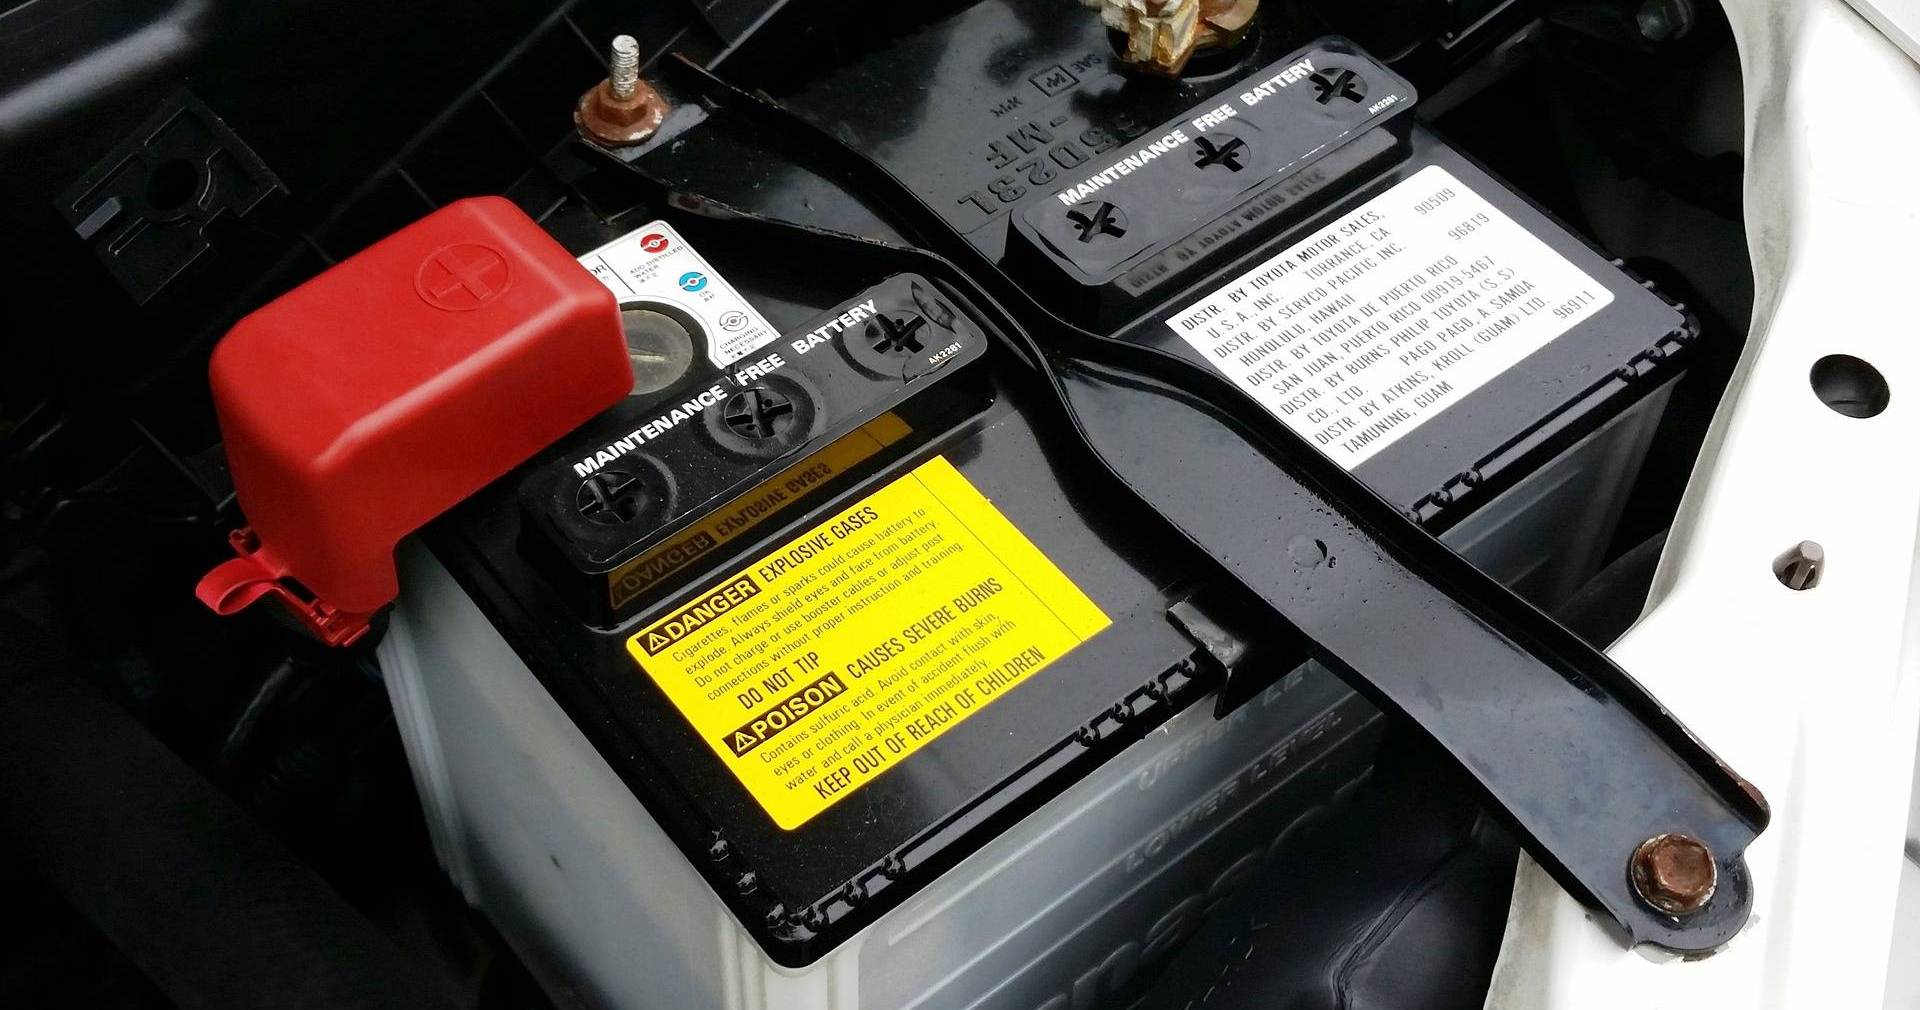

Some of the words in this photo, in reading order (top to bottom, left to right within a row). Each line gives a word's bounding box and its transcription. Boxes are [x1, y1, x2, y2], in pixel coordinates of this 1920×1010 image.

[1057, 129, 1190, 206] MAINTENANCE
[1192, 103, 1238, 132] FREE
[1239, 58, 1316, 107] BATTERY
[1226, 286, 1250, 303] BY
[1247, 258, 1299, 291] TOYOTA
[1294, 233, 1342, 263] MOTOR
[1337, 207, 1386, 238] SALES,
[1367, 225, 1392, 242] CA
[1411, 186, 1457, 216] 90509
[633, 264, 660, 278] WATER
[1237, 320, 1312, 368] HONOLULU,
[1307, 292, 1357, 325] HAWAII
[1445, 211, 1491, 241] 96819
[1255, 315, 1280, 332] BY
[1276, 285, 1329, 320] SERVCO
[1325, 256, 1379, 290] PACIFIC
[1288, 342, 1313, 360] BY
[1309, 313, 1361, 347] TOYOTA
[1357, 300, 1381, 317] DE
[1376, 272, 1428, 306] PUERTO
[1424, 254, 1459, 277] RICO
[573, 384, 729, 478] MAINTENANCE
[734, 353, 787, 387] FREE
[791, 299, 879, 355] BATTERY
[720, 327, 758, 349] CHARGING
[725, 330, 768, 354] NECESSARY
[928, 341, 962, 364] AK2281
[1270, 372, 1305, 396] SAN
[1300, 348, 1345, 378] JUAN,
[1338, 319, 1390, 354] PUERTO
[1387, 299, 1422, 324] RICO
[1322, 370, 1348, 388] BY
[1343, 342, 1392, 375] BURNS
[1388, 316, 1434, 348] PHILIP
[1430, 287, 1482, 322] TOYOTA
[1339, 402, 1418, 457] TAMUNING,
[1411, 379, 1454, 409] GUAM
[1551, 289, 1596, 320] 96911
[1357, 399, 1382, 417] BY
[1378, 366, 1436, 406] ATKINS,
[1430, 340, 1475, 372] KROLL
[1397, 338, 1438, 366] PAGO
[1435, 313, 1481, 345] PAGO,
[661, 577, 758, 641] DANGER
[757, 531, 835, 583] EXPLOSIVE
[828, 504, 880, 540] GASES
[670, 621, 734, 664] Cigarettes,
[730, 599, 770, 627] flames
[768, 593, 783, 605] or
[779, 570, 819, 598] sparks
[814, 553, 847, 576] could
[844, 536, 877, 559] cause
[873, 513, 915, 542] battery
[911, 506, 927, 519] to
[693, 671, 713, 688] Do
[711, 660, 733, 677] not
[730, 637, 771, 667] charge
[768, 631, 783, 643] or
[781, 618, 803, 635] use
[800, 593, 843, 622] booster
[839, 572, 877, 599] cables
[875, 566, 889, 578] or
[886, 545, 923, 572] adjust
[919, 532, 946, 552] post
[704, 657, 771, 701] connections
[767, 631, 813, 663] without
[810, 611, 848, 638] proper
[843, 575, 903, 615] instruction
[898, 564, 923, 582] and
[919, 538, 967, 571] training.
[728, 616, 773, 649] Always
[768, 597, 805, 623] shield
[802, 583, 831, 604] eyes
[827, 570, 850, 587] and
[847, 555, 875, 575] face
[871, 540, 900, 561] from
[736, 685, 765, 710] DO
[761, 666, 797, 695] NOT
[792, 649, 825, 676] TIP
[748, 675, 844, 741] POISON
[844, 635, 907, 680] CAUSES
[900, 604, 958, 645] SEVERE
[950, 575, 1004, 614] BURNS
[758, 727, 810, 764] Contains
[805, 700, 852, 734] sulfuric
[874, 664, 910, 691] Avoid
[906, 642, 949, 671] contact
[944, 624, 974, 646] with
[771, 754, 803, 779] eyes
[799, 746, 815, 760] or
[859, 706, 876, 721] In
[873, 688, 907, 713] event
[903, 678, 921, 694] of
[917, 651, 965, 684] accident
[960, 633, 992, 657] flush
[987, 617, 1017, 639] with
[783, 764, 820, 791] water
[818, 749, 843, 769] and
[838, 734, 864, 755] call
[862, 730, 874, 741] a
[870, 697, 925, 736] physician
[812, 765, 857, 800] KEEP
[850, 745, 889, 776] OUT
[882, 731, 911, 755] OF
[904, 700, 959, 741] REACH
[952, 687, 980, 711] OF
[973, 644, 1047, 696] CHILDREN
